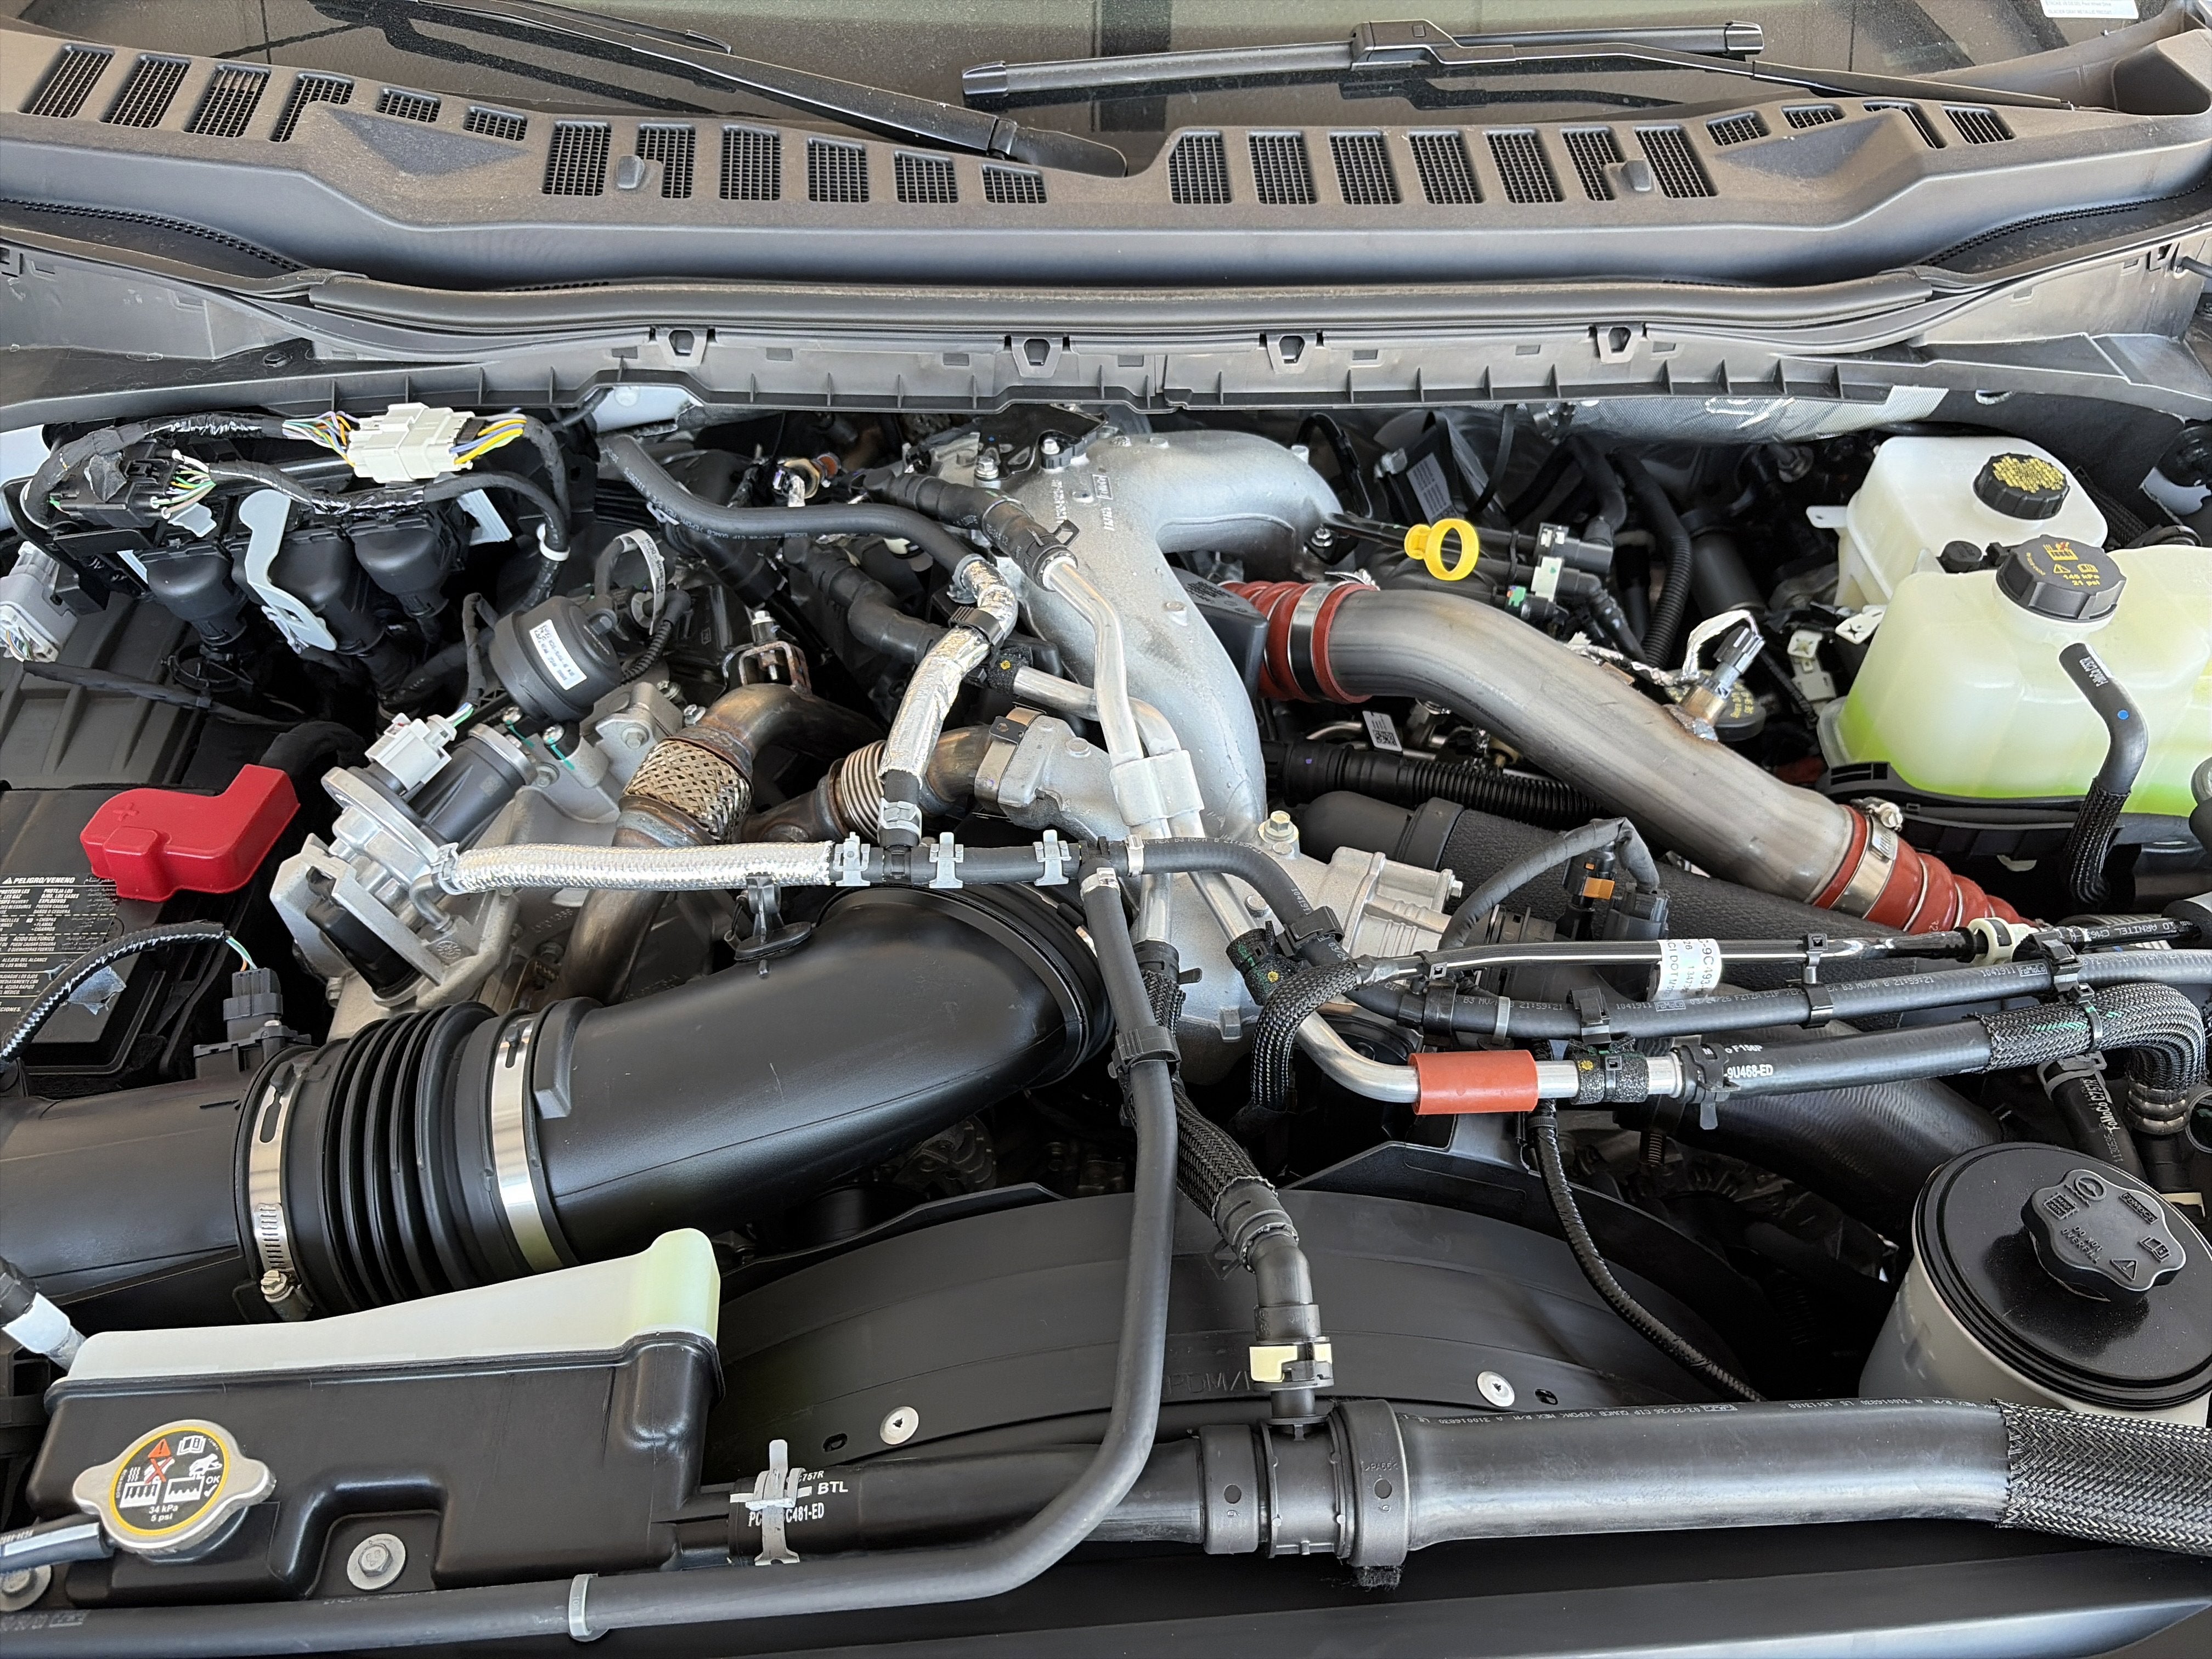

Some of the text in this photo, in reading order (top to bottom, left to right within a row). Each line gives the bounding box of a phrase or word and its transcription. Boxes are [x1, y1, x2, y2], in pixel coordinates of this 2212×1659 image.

[1519, 1002, 1563, 1011] 21:59:21
[2050, 1203, 2062, 1215] MIN
[2057, 1197, 2070, 1211] MAX
[2073, 1226, 2103, 1251] DO NOT
[2061, 1228, 2100, 1264] OVERFILL
[205, 1475, 221, 1485] OK
[817, 1481, 849, 1495] BTL
[149, 1504, 179, 1514] 34 kPa
[158, 1513, 173, 1522] psi
